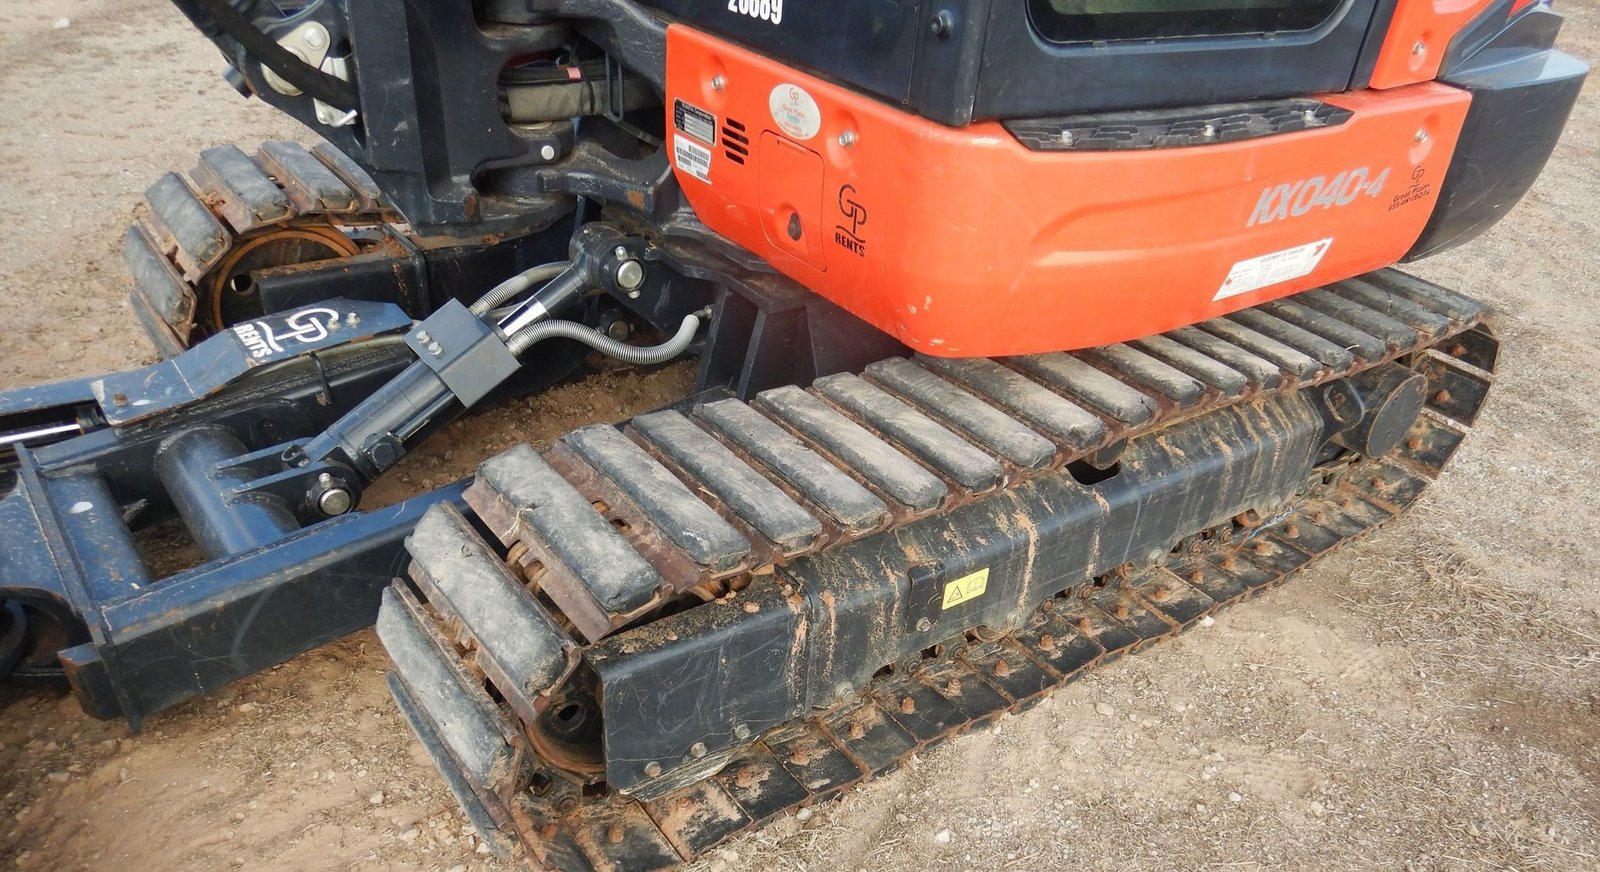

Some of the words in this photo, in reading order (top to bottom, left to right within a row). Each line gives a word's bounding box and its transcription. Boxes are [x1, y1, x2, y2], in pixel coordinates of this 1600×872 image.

[1246, 167, 1391, 228] KX040-4
[835, 231, 866, 258] RENTS
[233, 323, 273, 358] RENTS
